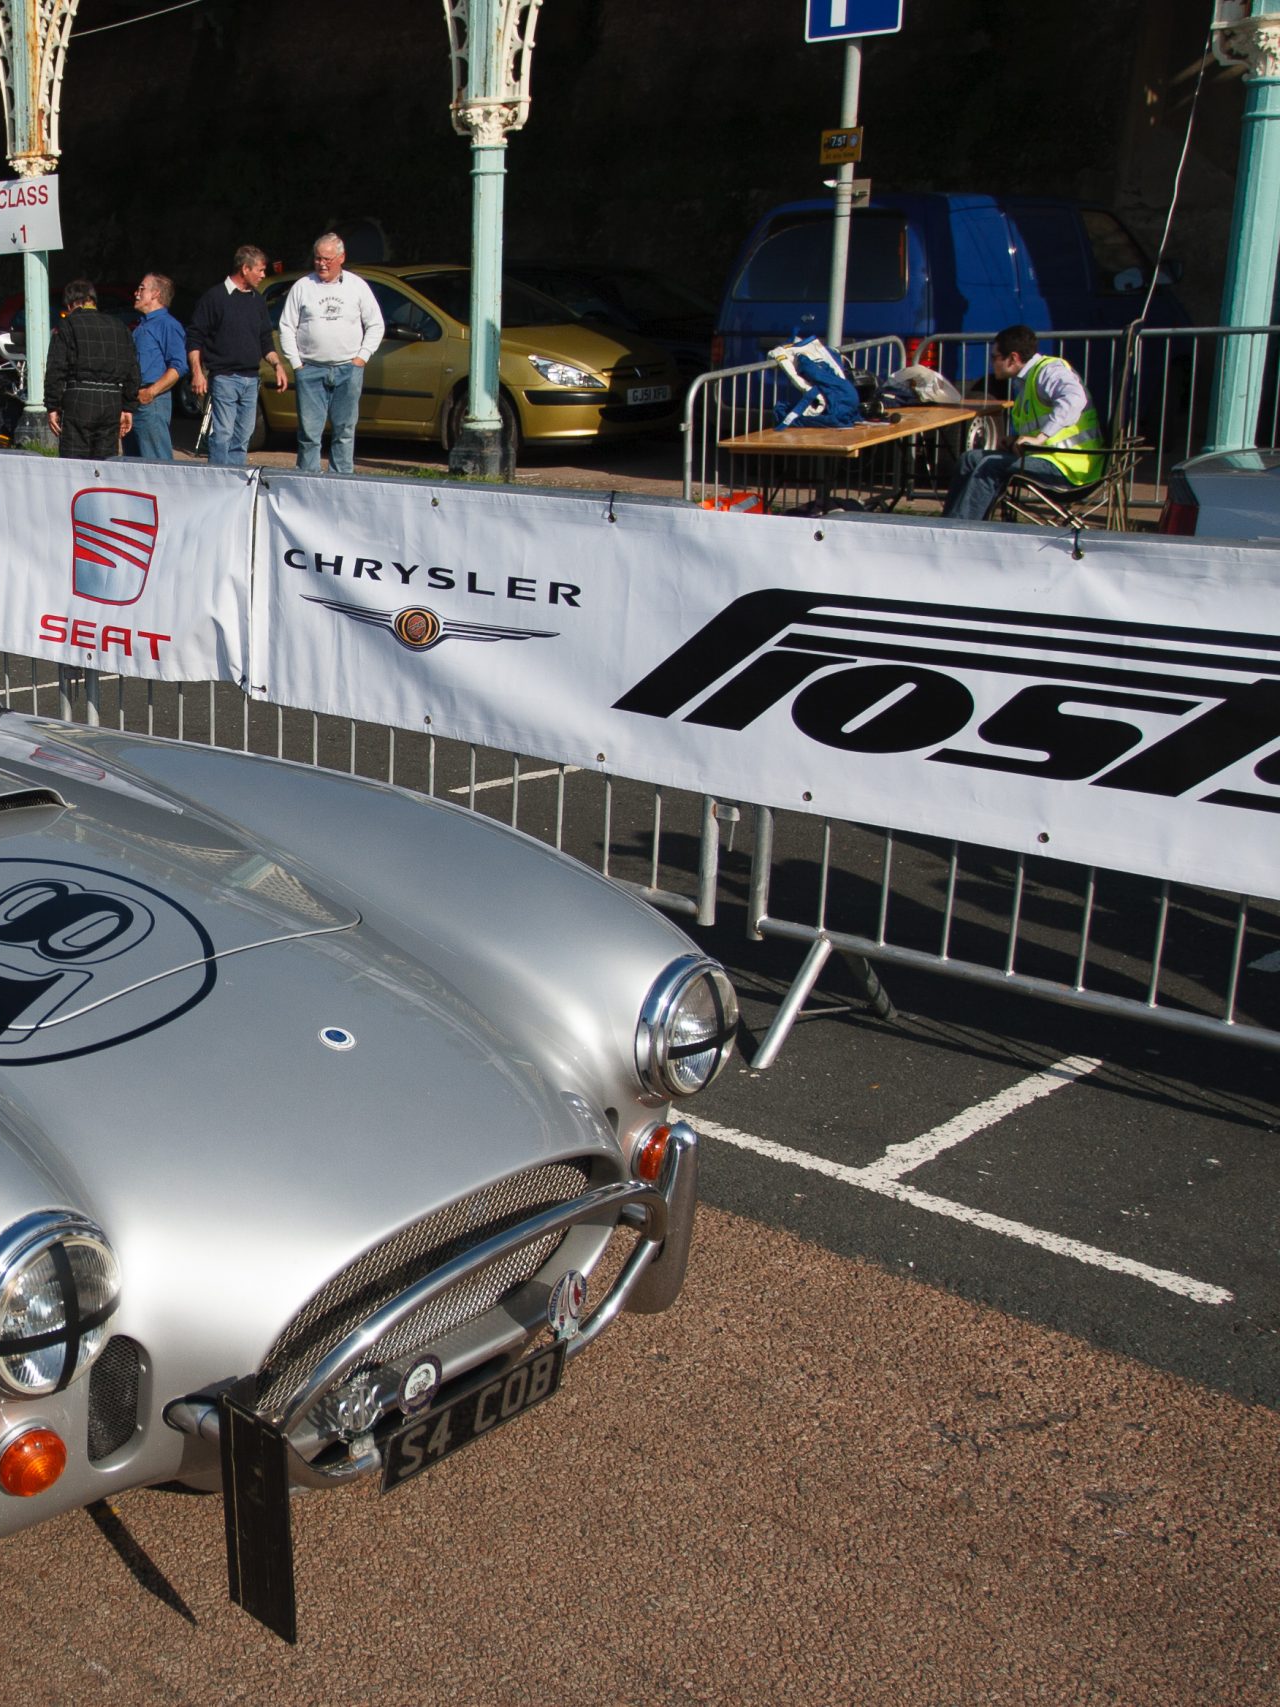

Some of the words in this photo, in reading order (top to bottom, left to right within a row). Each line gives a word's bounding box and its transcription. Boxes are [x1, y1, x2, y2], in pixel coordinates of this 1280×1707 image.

[19, 224, 27, 244] 1
[283, 548, 582, 608] CHRYSLER
[39, 614, 171, 661] SEAT
[398, 1410, 454, 1477] S4
[473, 1352, 555, 1434] COB
